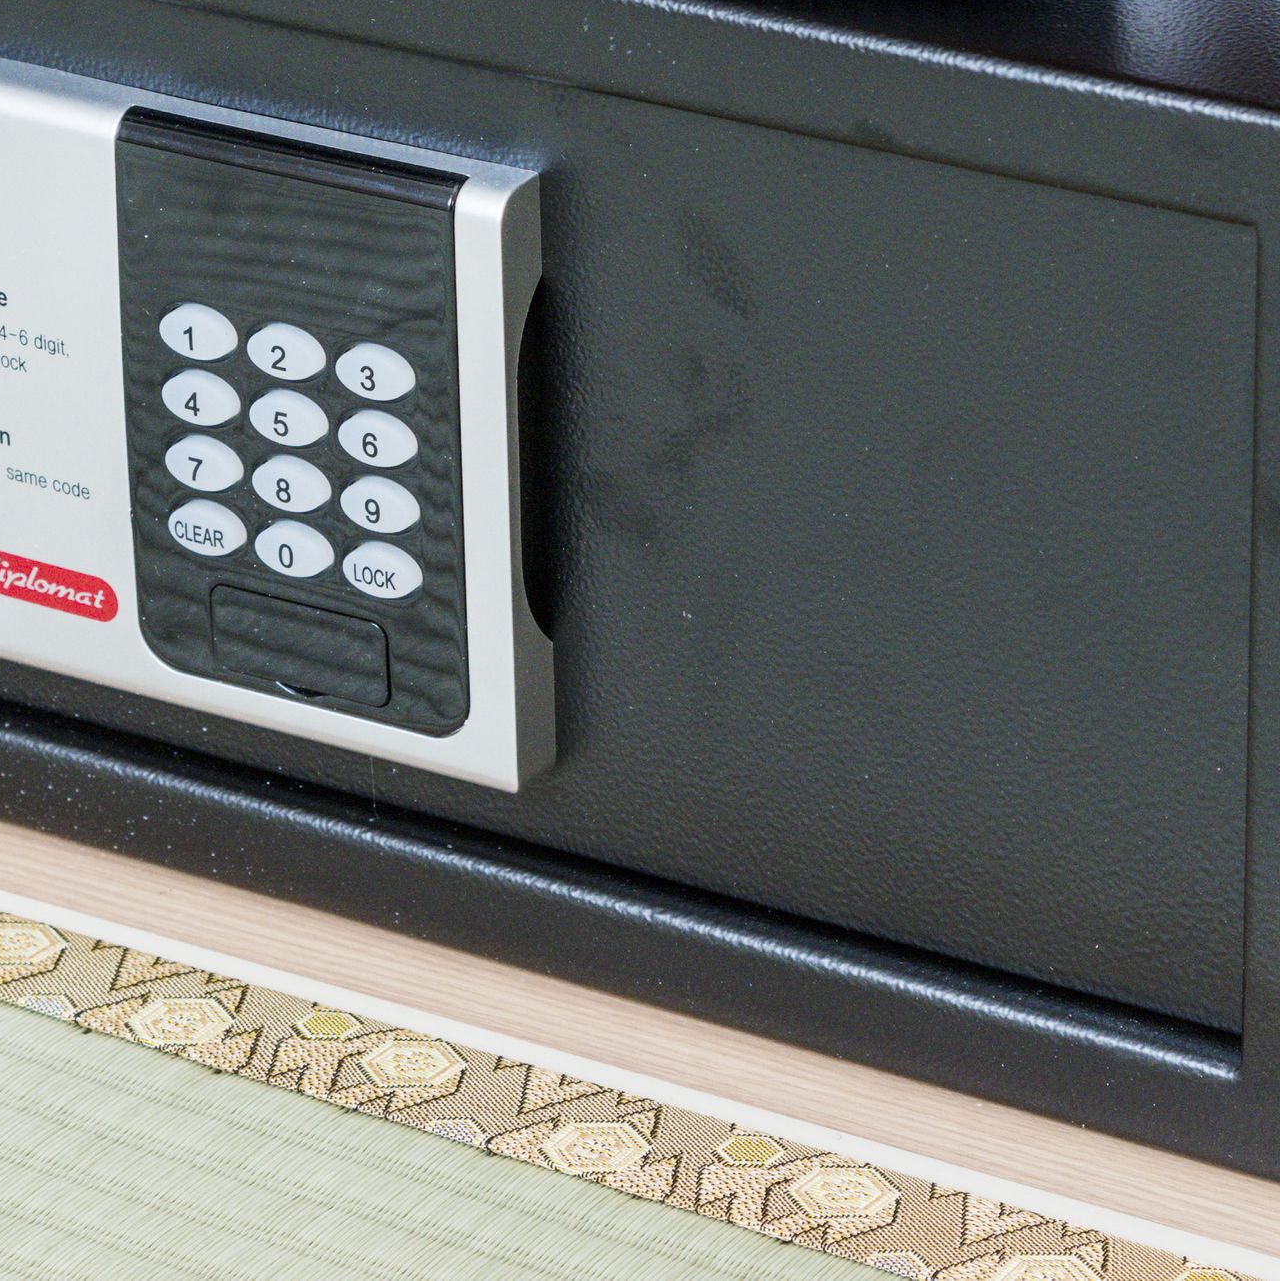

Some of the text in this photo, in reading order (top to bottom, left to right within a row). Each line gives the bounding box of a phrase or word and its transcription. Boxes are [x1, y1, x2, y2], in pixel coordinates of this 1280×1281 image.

[182, 327, 195, 351] 1
[270, 346, 287, 371] 2
[358, 366, 376, 392] 3
[183, 392, 200, 417] 4
[273, 412, 289, 437] 5
[361, 433, 378, 458] 6
[187, 457, 203, 481] 7
[6, 467, 47, 488] same
[52, 479, 89, 499] code
[275, 479, 292, 504] 8
[364, 499, 381, 524] 9
[174, 521, 225, 549] CLEAR
[278, 544, 294, 569] 0
[352, 564, 396, 590] LOCK
